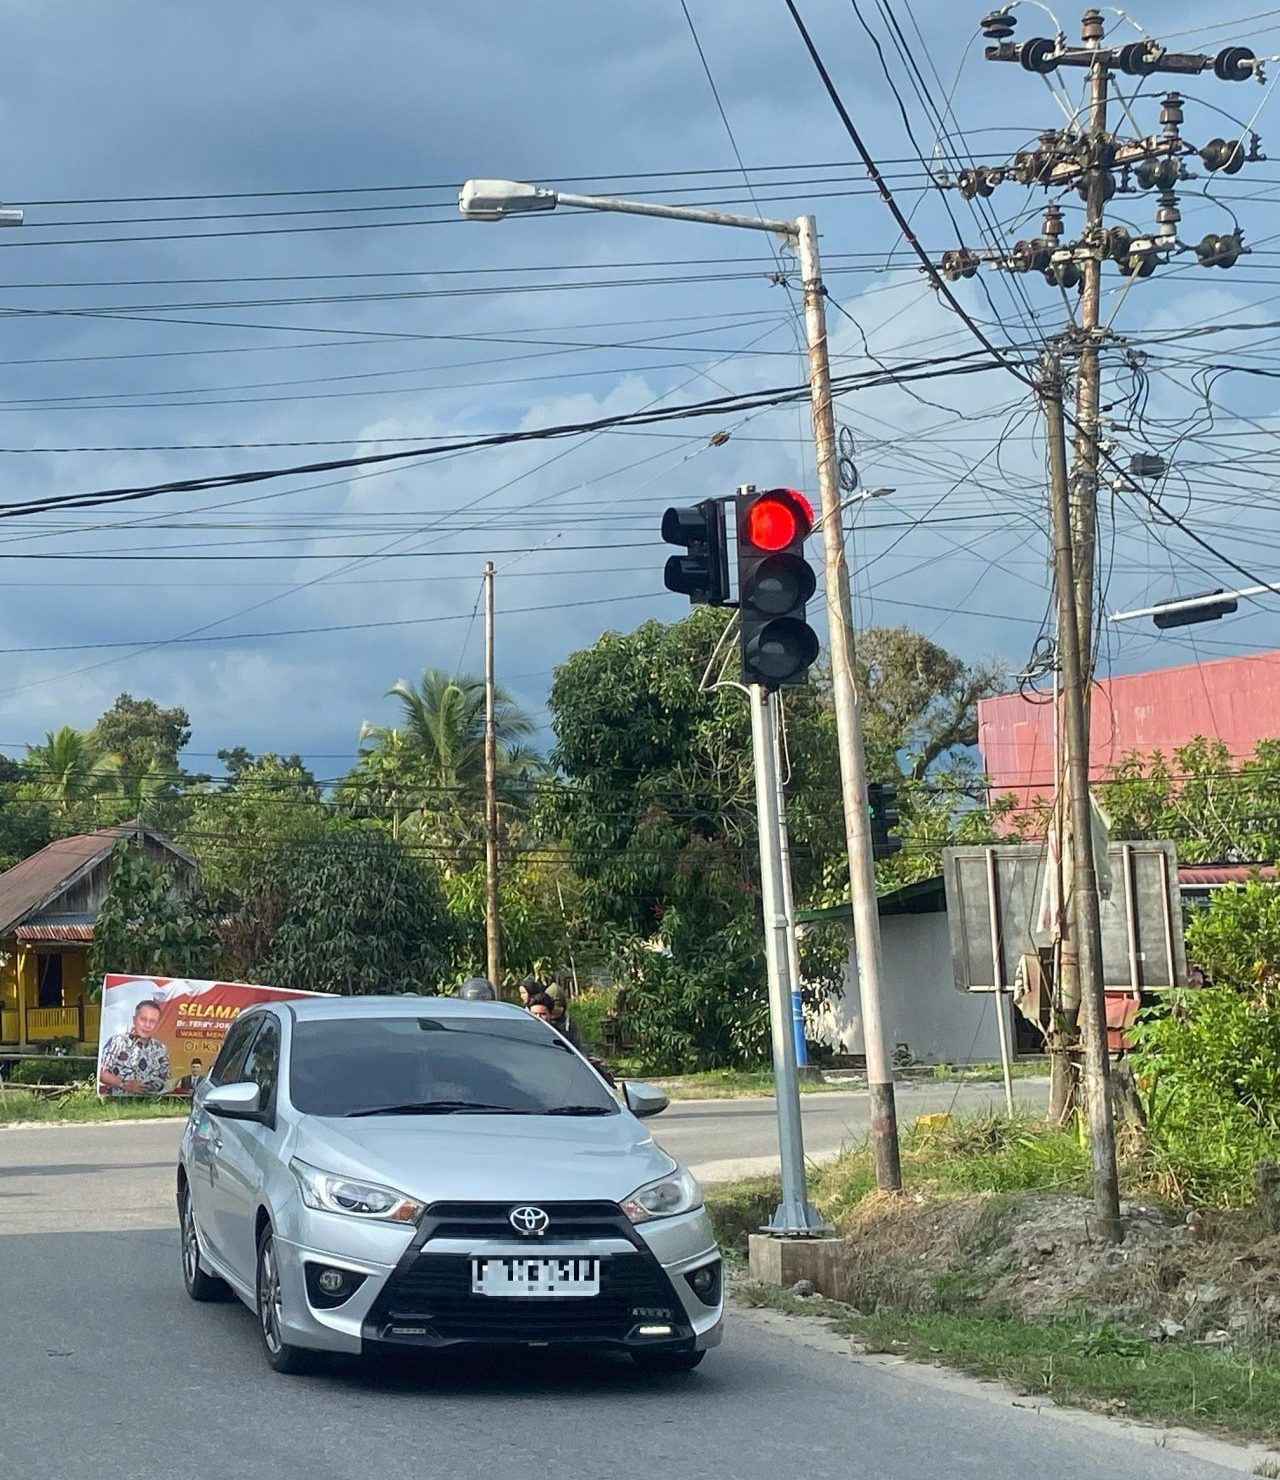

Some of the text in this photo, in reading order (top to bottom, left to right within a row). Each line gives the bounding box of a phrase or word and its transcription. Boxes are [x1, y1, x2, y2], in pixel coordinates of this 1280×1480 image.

[178, 1002, 241, 1019] SELAMA
[181, 1030, 205, 1038] WAKIL
[184, 1040, 199, 1052] Di
